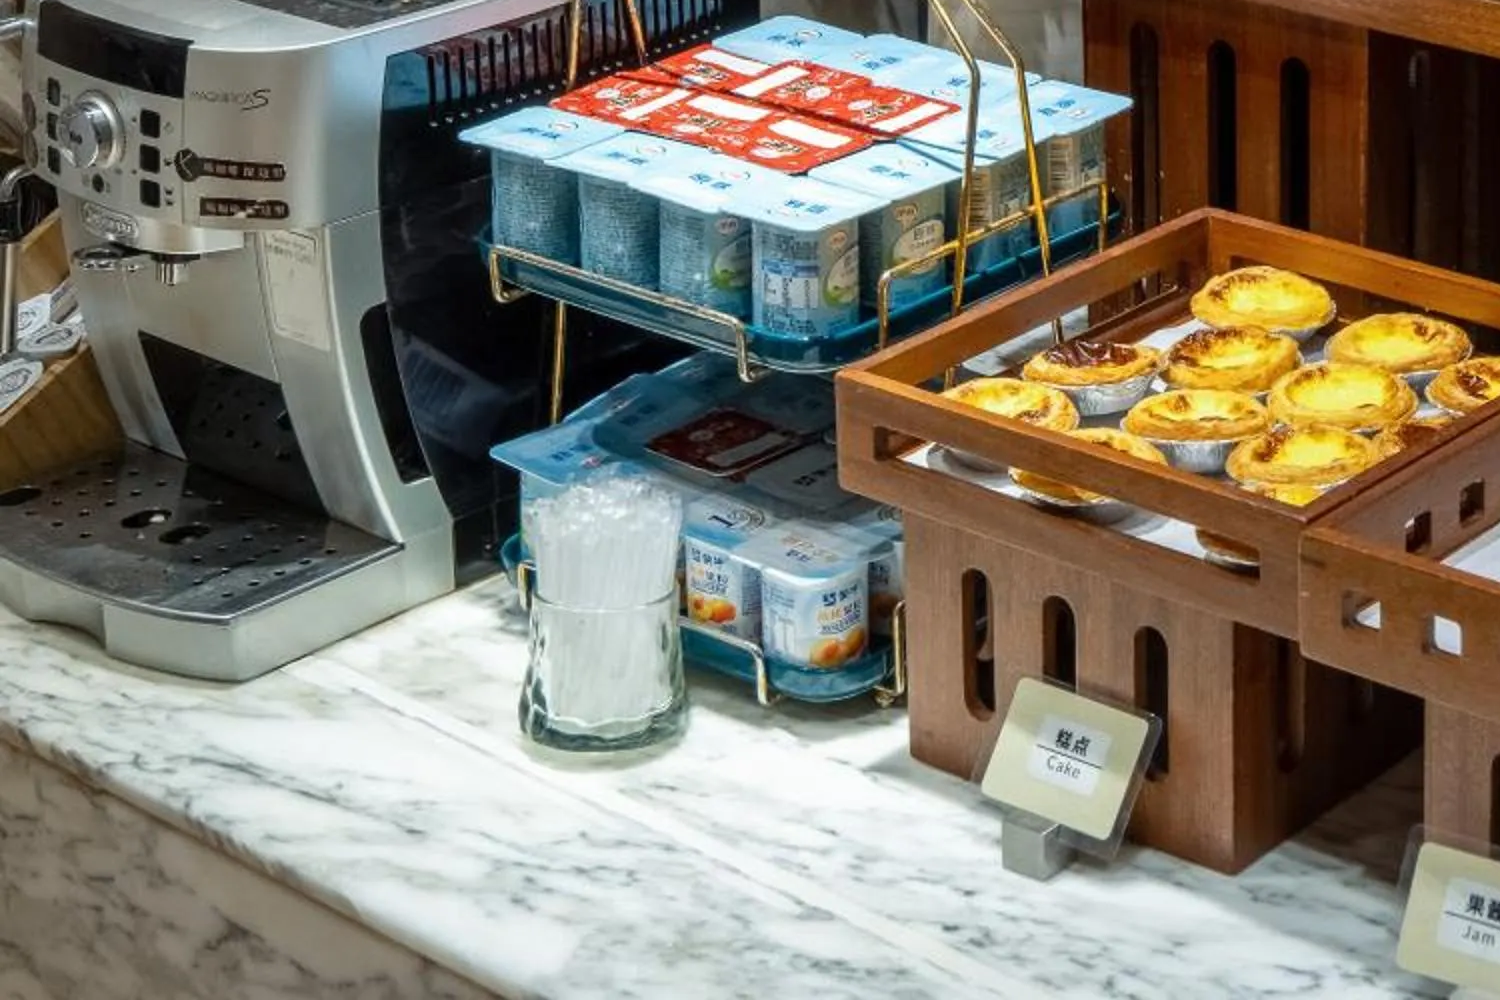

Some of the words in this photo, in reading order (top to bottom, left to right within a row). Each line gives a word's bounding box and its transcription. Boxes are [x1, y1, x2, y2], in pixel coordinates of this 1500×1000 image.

[1055, 728, 1091, 757] 糕点
[1046, 755, 1081, 779] Cake
[1461, 925, 1495, 948] Jam
